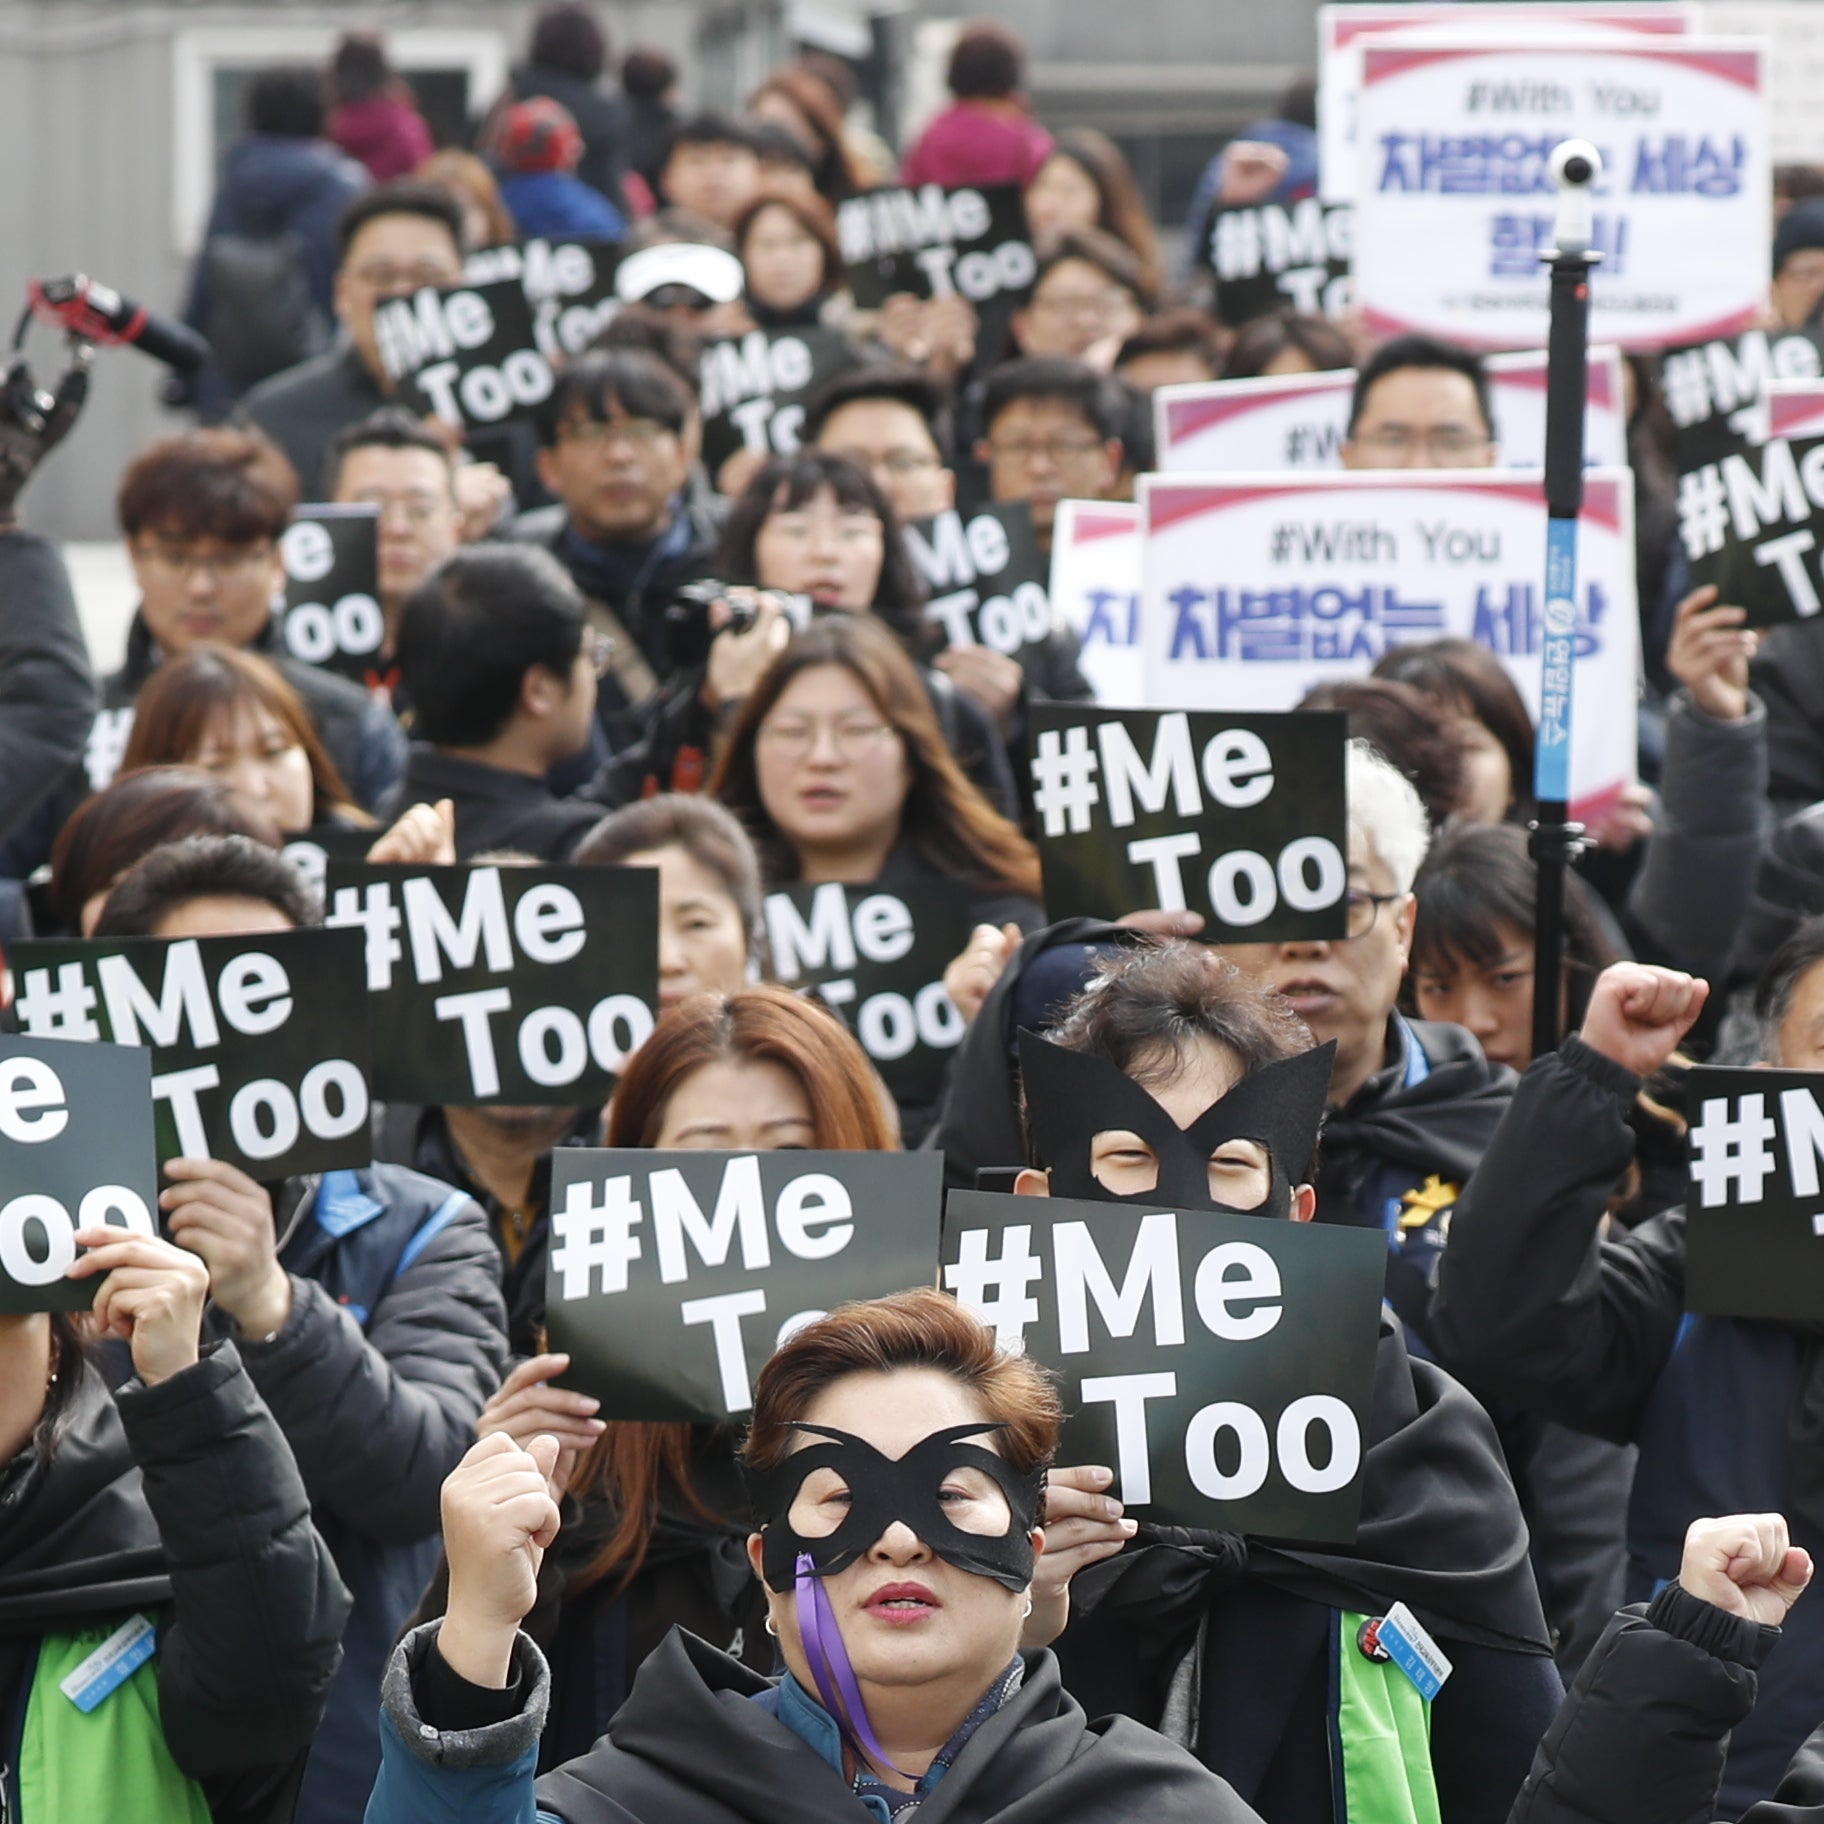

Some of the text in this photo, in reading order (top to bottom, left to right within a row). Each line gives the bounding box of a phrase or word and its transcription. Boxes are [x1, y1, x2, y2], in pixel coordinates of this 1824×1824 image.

[1632, 133, 1748, 197] 세상
[838, 184, 991, 264] #Me
[915, 239, 1038, 300] Too
[376, 287, 494, 379] #Me
[1662, 332, 1820, 427] #Me
[417, 347, 554, 425] Too
[904, 510, 1011, 588] Me
[1270, 521, 1500, 564] #With You
[285, 593, 385, 662] oo
[927, 579, 1050, 656] Too
[1032, 711, 1275, 838] #Me
[1129, 831, 1346, 928] Too
[326, 867, 587, 993] #Me
[767, 881, 914, 973] Me
[16, 939, 295, 1047] #Me
[436, 988, 659, 1100] Too
[152, 1057, 370, 1167] Too
[552, 1154, 855, 1301] #Me
[946, 1213, 1283, 1358] #Me
[1081, 1371, 1362, 1506] Too
